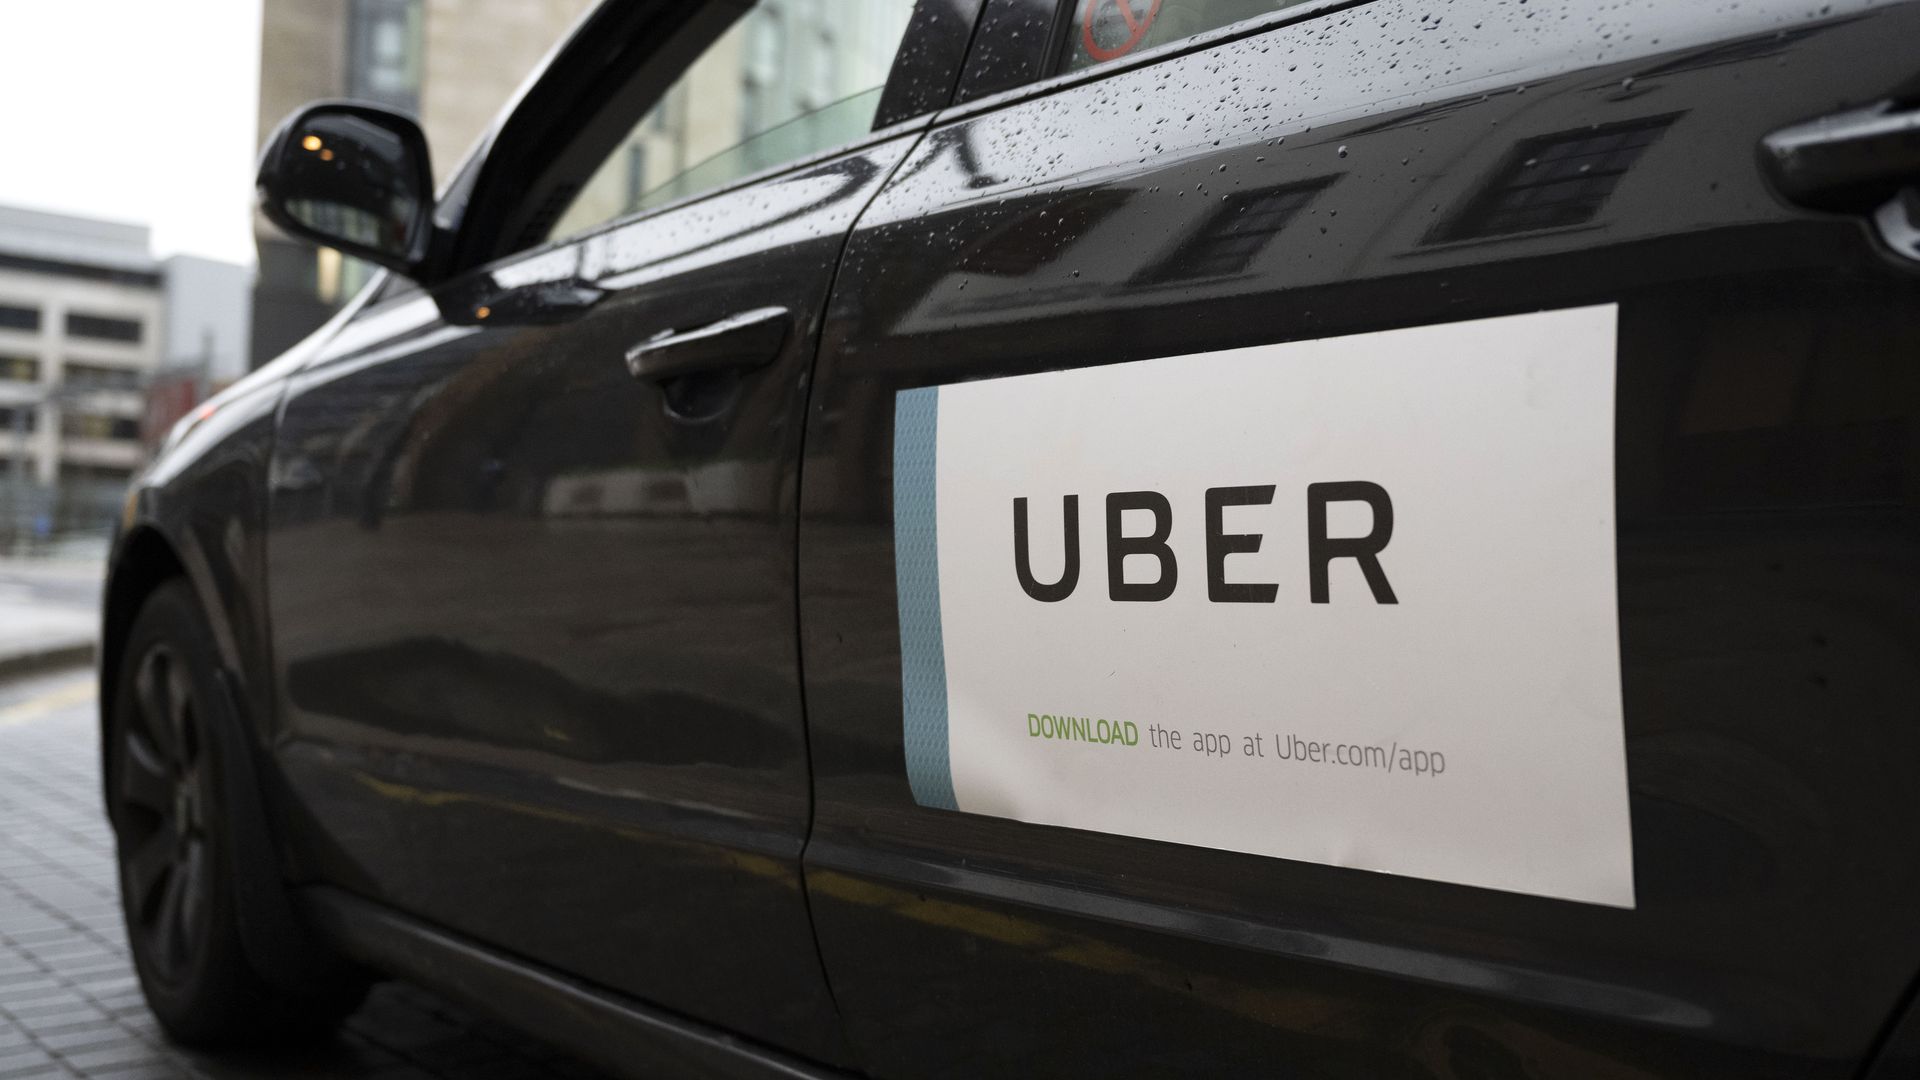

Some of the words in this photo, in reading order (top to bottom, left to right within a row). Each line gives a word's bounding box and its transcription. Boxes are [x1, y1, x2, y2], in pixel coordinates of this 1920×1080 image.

[1013, 480, 1399, 605] UBER
[1027, 713, 1139, 747] DOWNLOAD
[1149, 723, 1182, 751] the
[1193, 730, 1231, 758] app
[1243, 732, 1264, 758] at
[1275, 734, 1446, 777] Uber.com/app
